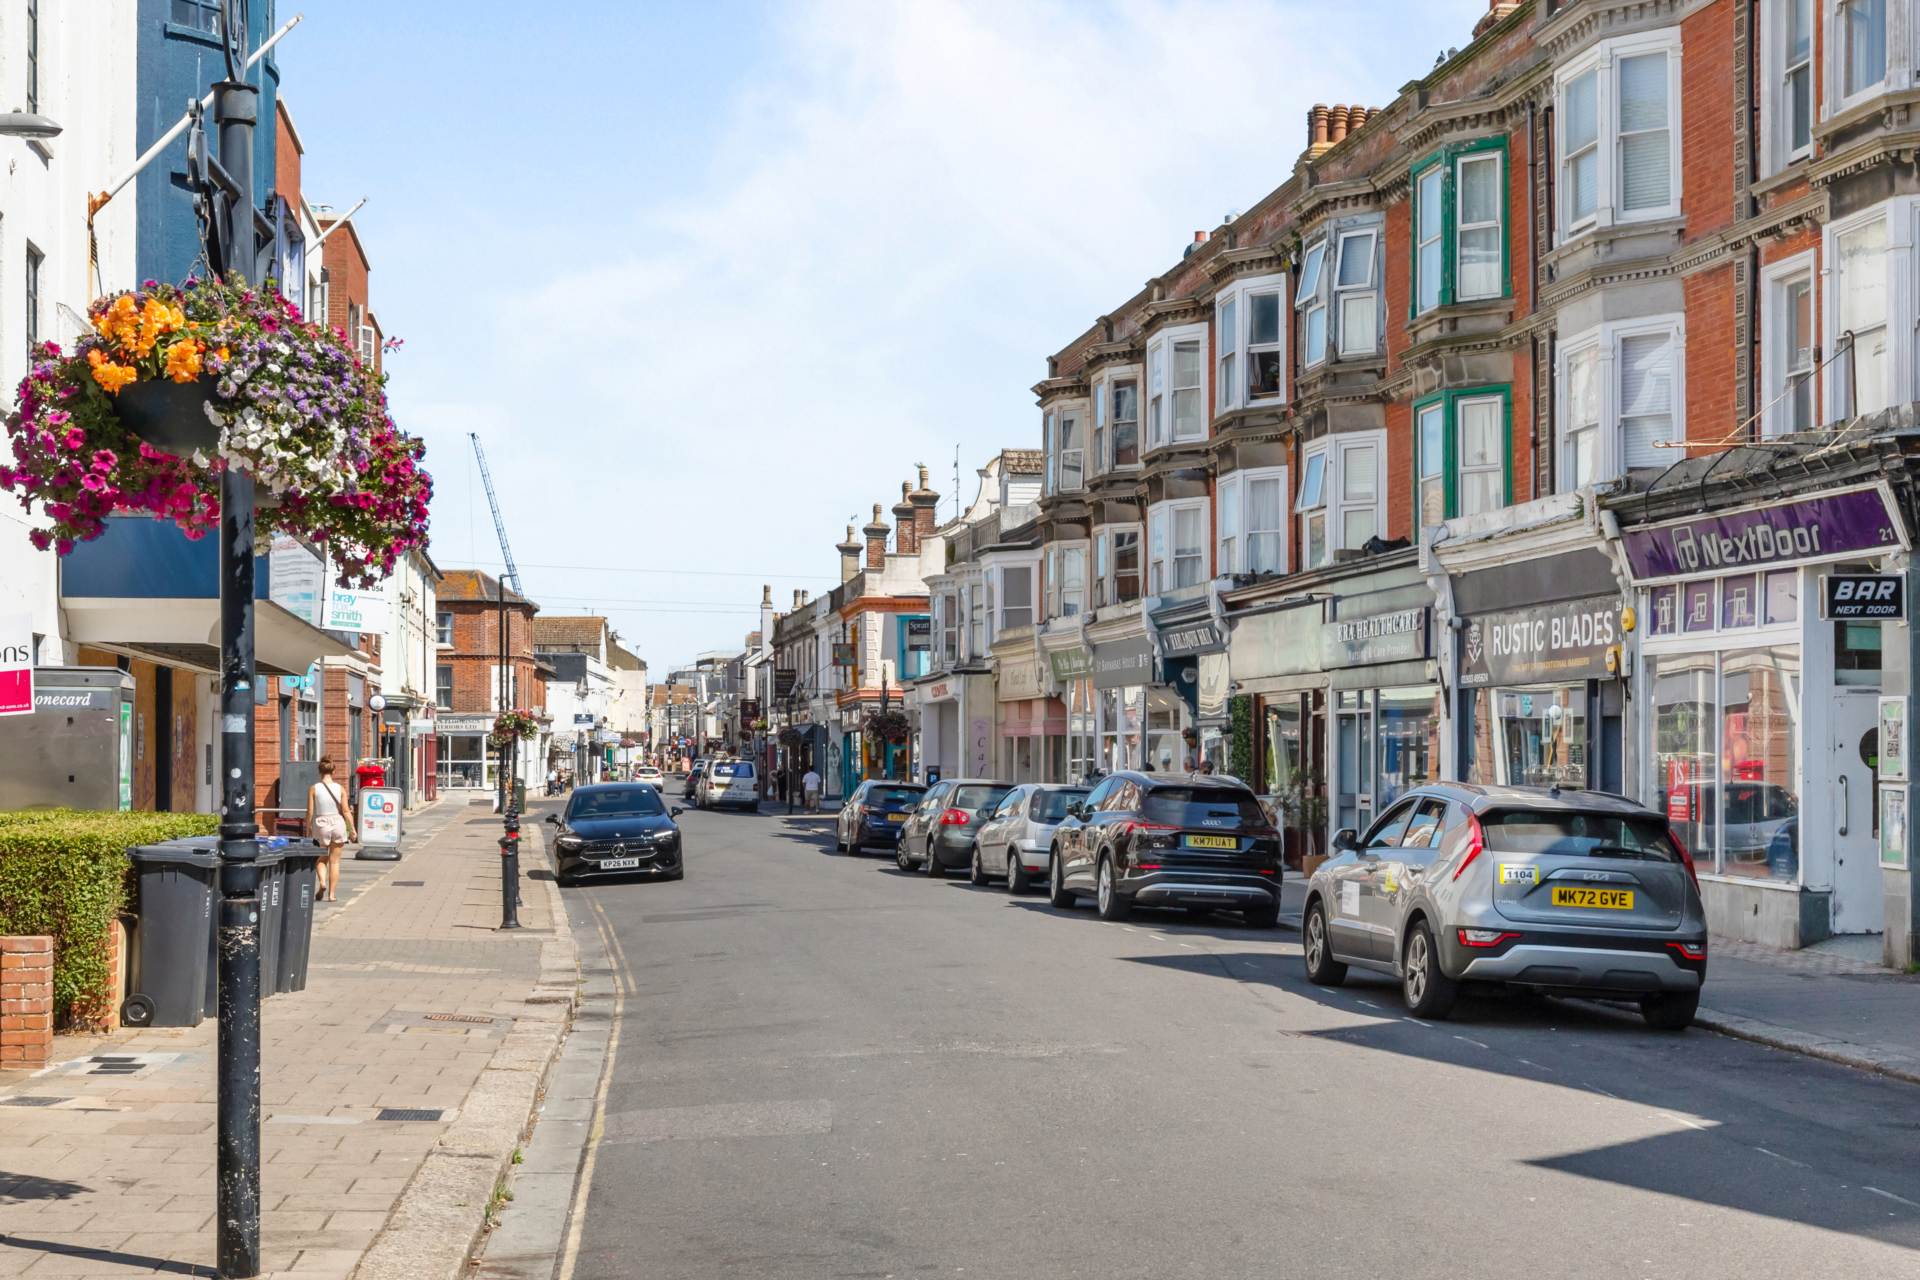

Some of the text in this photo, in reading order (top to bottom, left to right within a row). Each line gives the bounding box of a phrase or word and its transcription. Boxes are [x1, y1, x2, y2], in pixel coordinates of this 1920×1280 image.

[1878, 527, 1894, 542] 21
[1834, 581, 1897, 600] BAR
[332, 591, 357, 606] bray
[331, 609, 363, 622] smith
[1835, 604, 1897, 615] NEXT DOOR
[1356, 611, 1419, 640] HEALTHCARE
[1493, 610, 1614, 656] RUSTIC BLADES
[0, 645, 30, 663] ns
[34, 692, 91, 706] onecard
[1507, 870, 1533, 879] 1104
[1558, 891, 1628, 907] MK72 GVE
